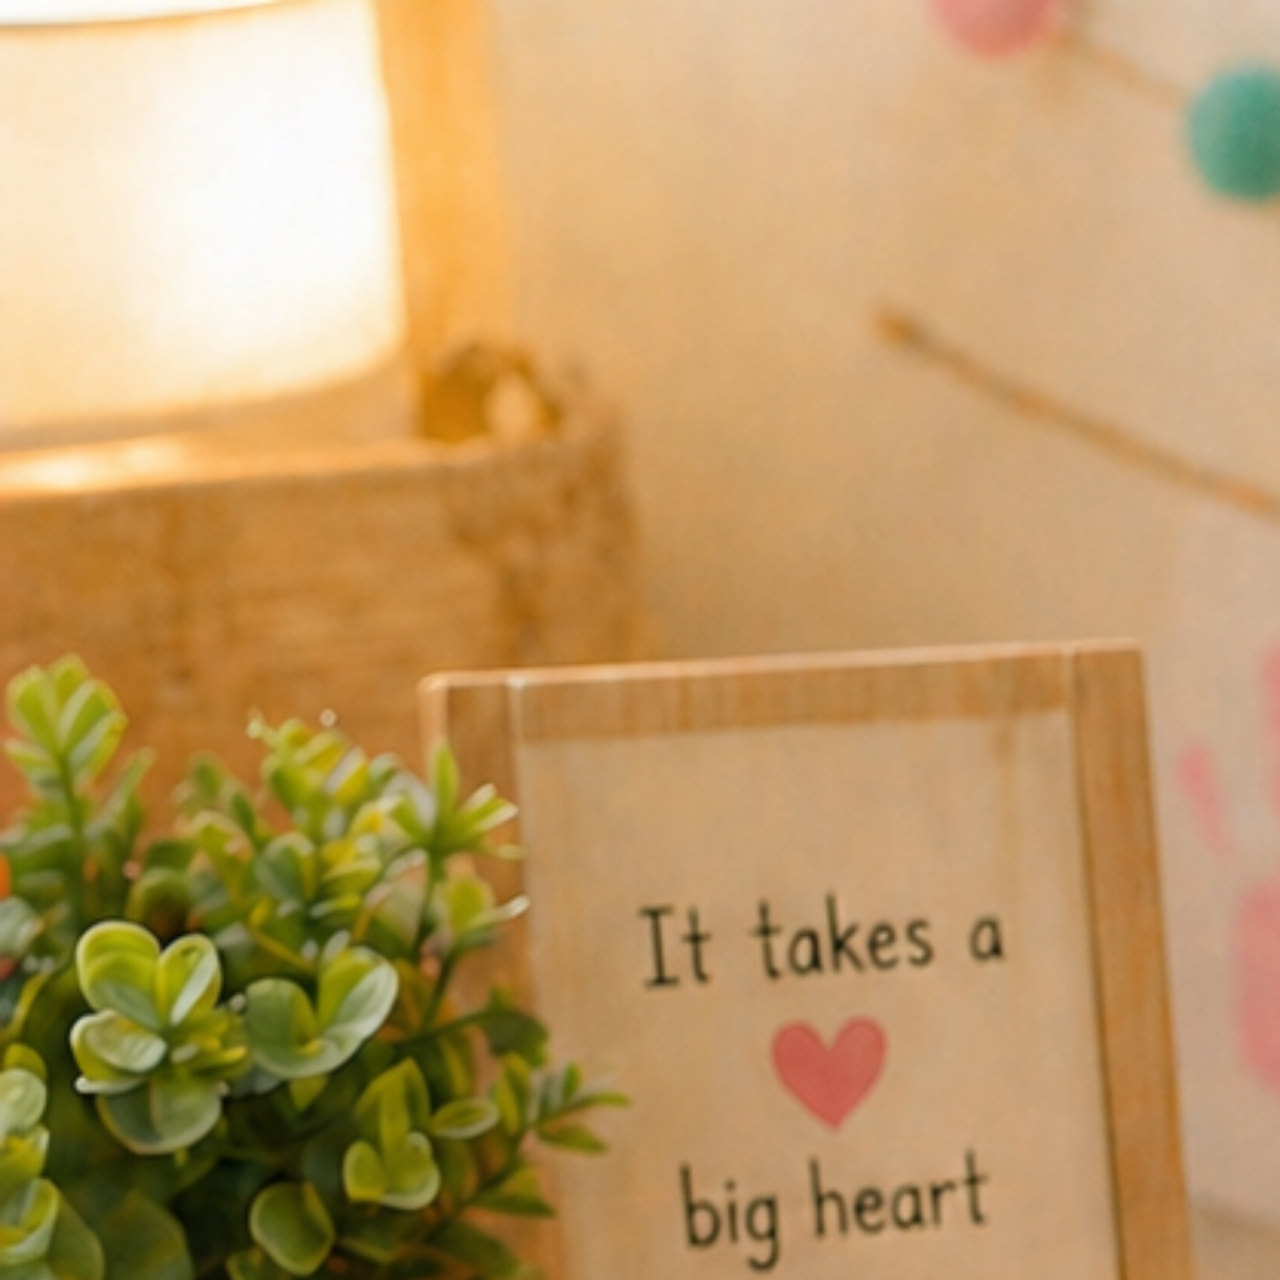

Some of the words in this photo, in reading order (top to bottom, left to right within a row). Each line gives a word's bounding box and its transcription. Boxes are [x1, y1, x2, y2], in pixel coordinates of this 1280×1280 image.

[639, 904, 710, 990] It
[752, 890, 934, 983] takes
[969, 915, 1005, 963] a
[679, 1165, 781, 1274] big
[808, 1152, 986, 1239] heart
